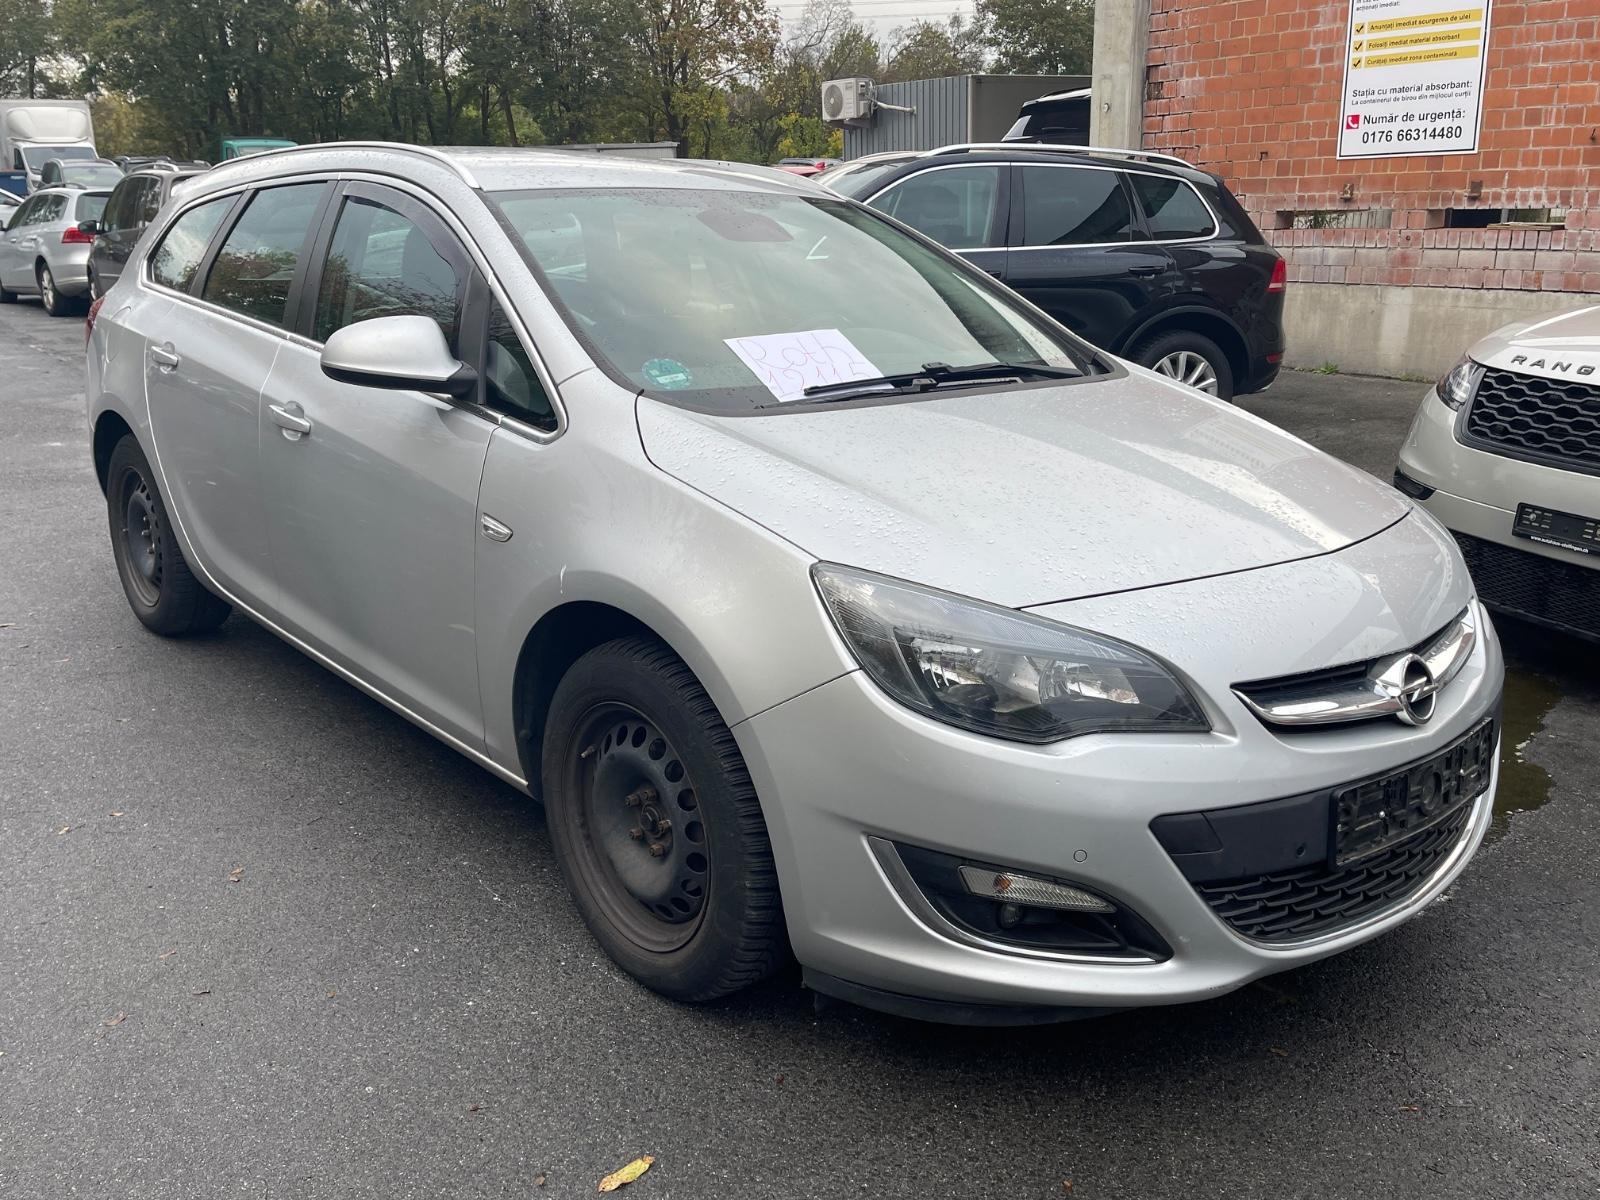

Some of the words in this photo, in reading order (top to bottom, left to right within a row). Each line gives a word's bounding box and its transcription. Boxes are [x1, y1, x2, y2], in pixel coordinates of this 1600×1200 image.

[1395, 19, 1417, 28] imediat
[1418, 16, 1449, 25] scurgerea
[1388, 38, 1408, 47] imediat
[1409, 36, 1431, 44] material
[1432, 33, 1460, 42] absorbant
[1388, 55, 1408, 63] imediat
[1389, 84, 1423, 94] material
[1425, 80, 1473, 91] absorbant:
[1359, 97, 1392, 105] containerul
[1363, 114, 1398, 125] Număr
[1401, 112, 1415, 121] de
[1362, 130, 1393, 144] 0176
[1397, 126, 1463, 141] 66314480
[1510, 355, 1596, 375] RANG
